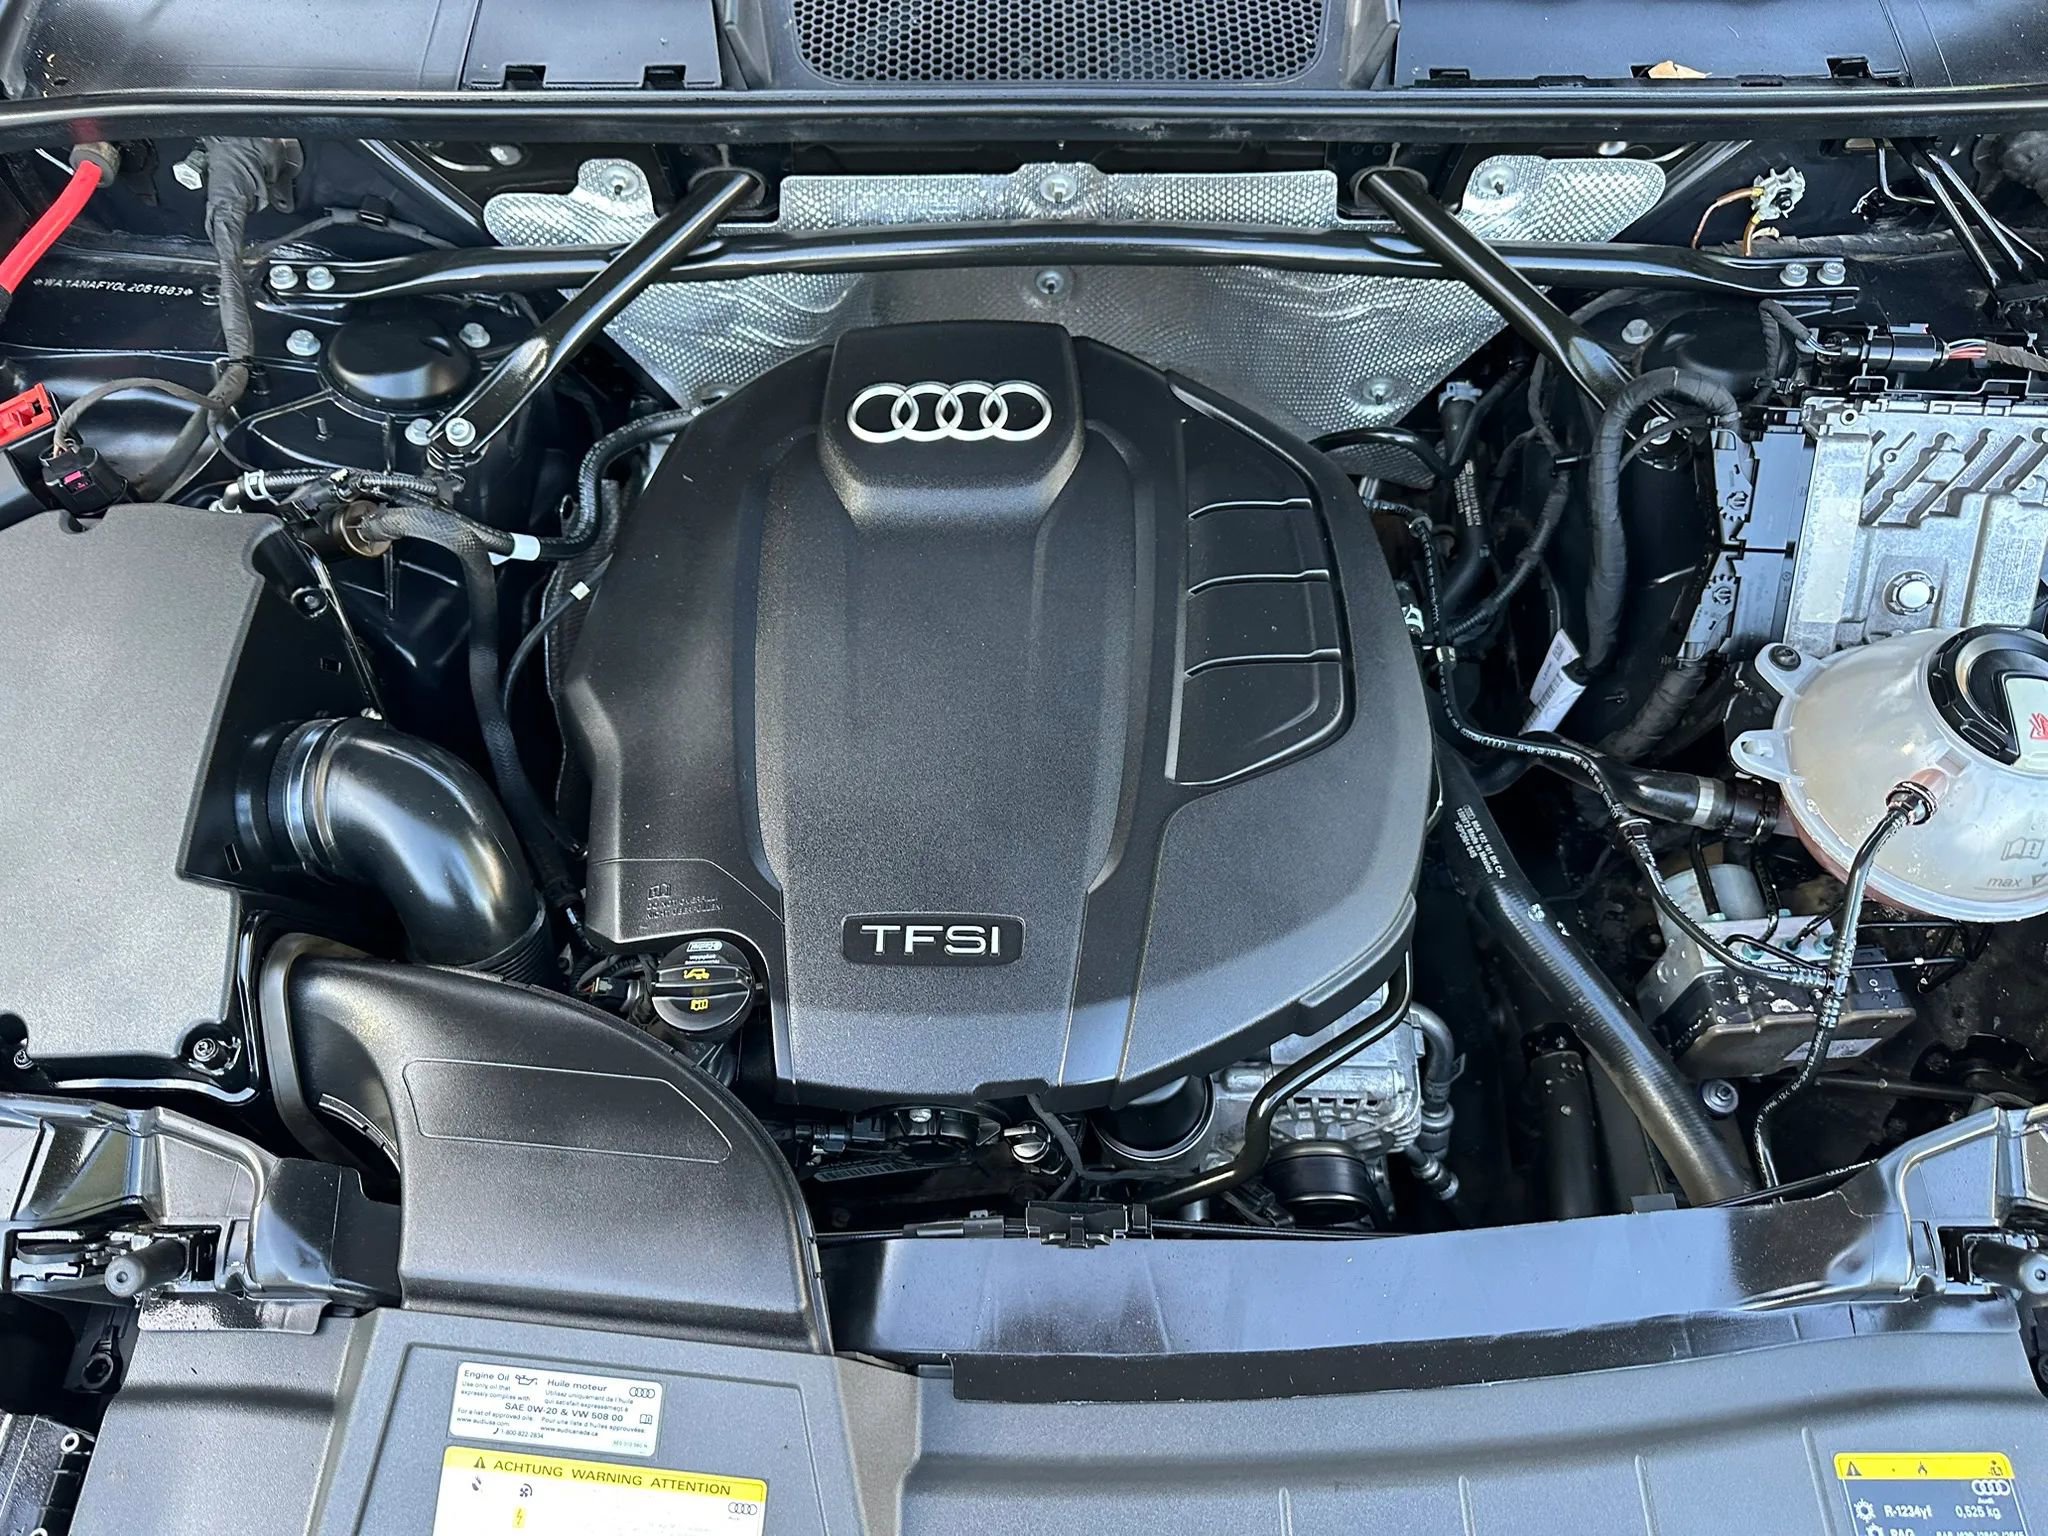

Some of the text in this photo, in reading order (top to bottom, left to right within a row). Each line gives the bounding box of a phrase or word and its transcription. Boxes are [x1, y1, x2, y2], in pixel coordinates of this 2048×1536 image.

[1479, 851, 1493, 874] Mexico
[1986, 876, 2023, 888] max
[861, 925, 999, 954] TFSI
[464, 1370, 509, 1382] Engine Oil
[547, 1378, 607, 1392] Huile moteur
[505, 1402, 623, 1422] SAE 0W-20 & VW 508 00
[493, 1459, 732, 1496] ACHTUNG WARNING ATTENTION
[1986, 1504, 2001, 1520] kg
